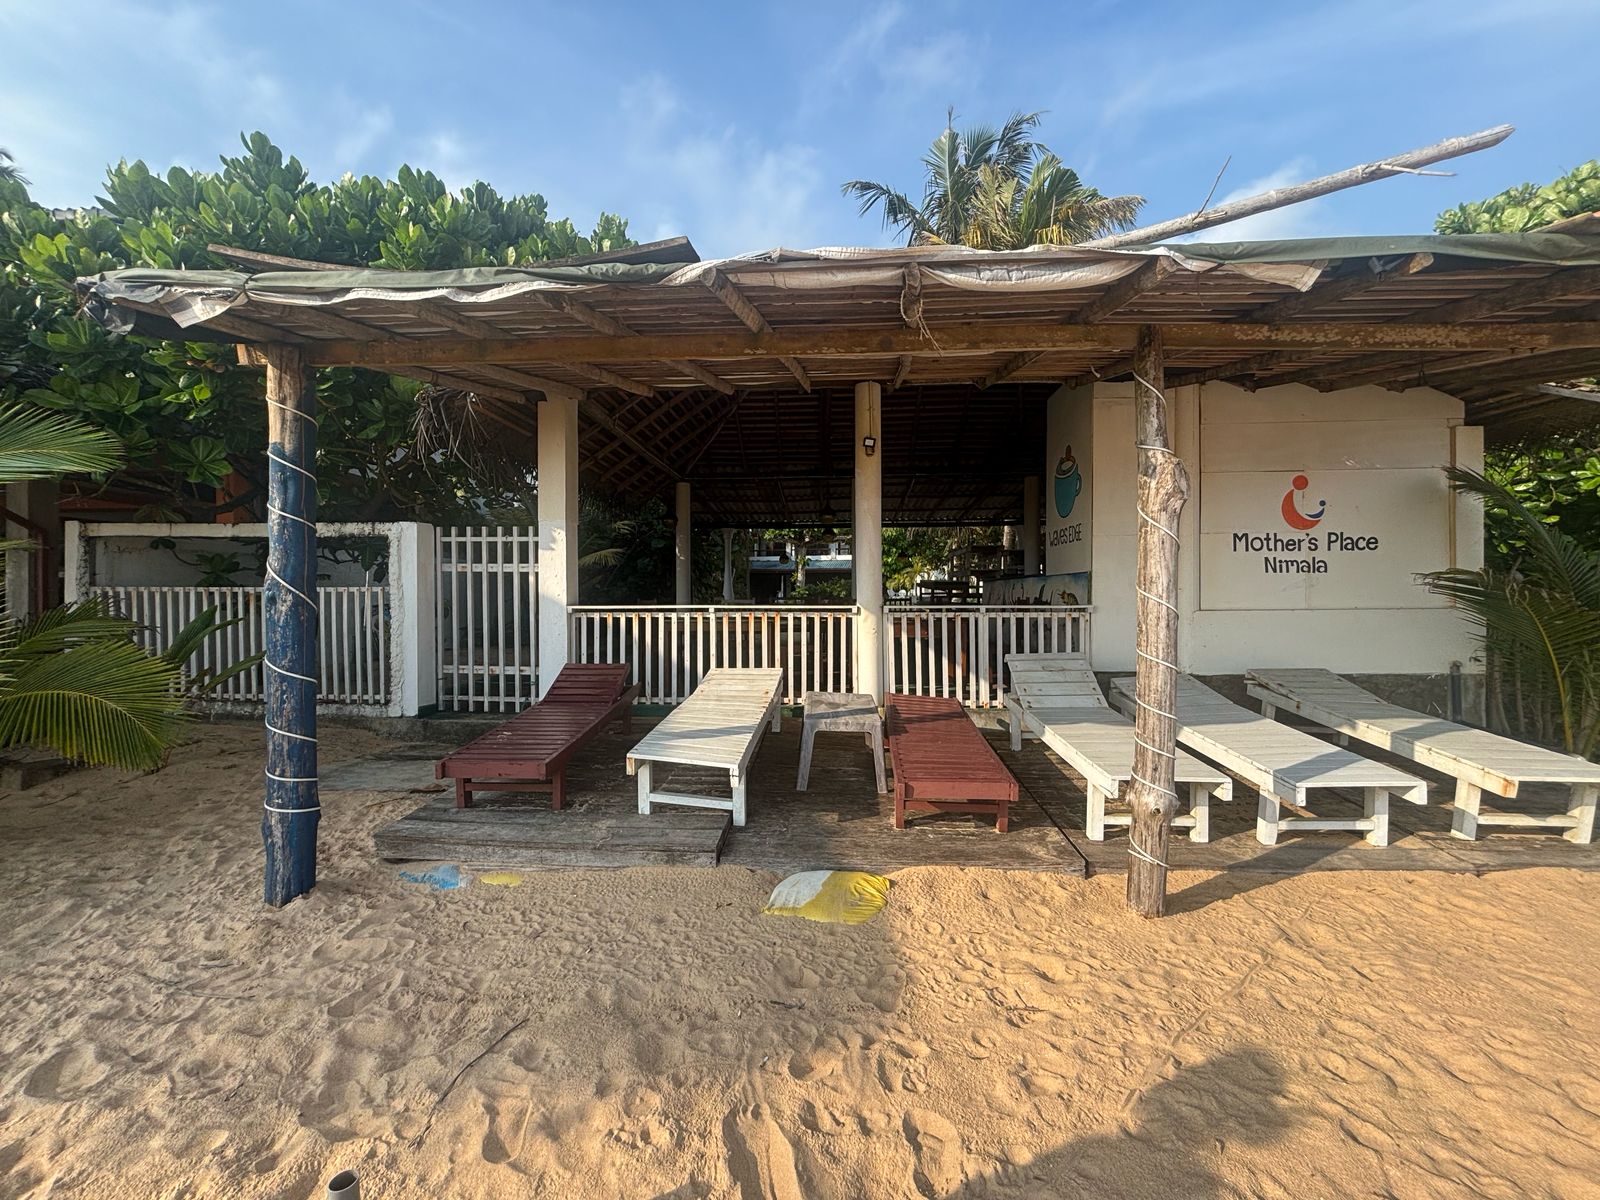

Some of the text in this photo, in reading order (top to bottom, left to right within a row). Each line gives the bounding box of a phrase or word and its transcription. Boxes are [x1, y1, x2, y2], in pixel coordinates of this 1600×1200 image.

[1068, 522, 1082, 544] EDGE
[1232, 531, 1379, 552] Mother's Place
[1264, 556, 1328, 574] Nimala
